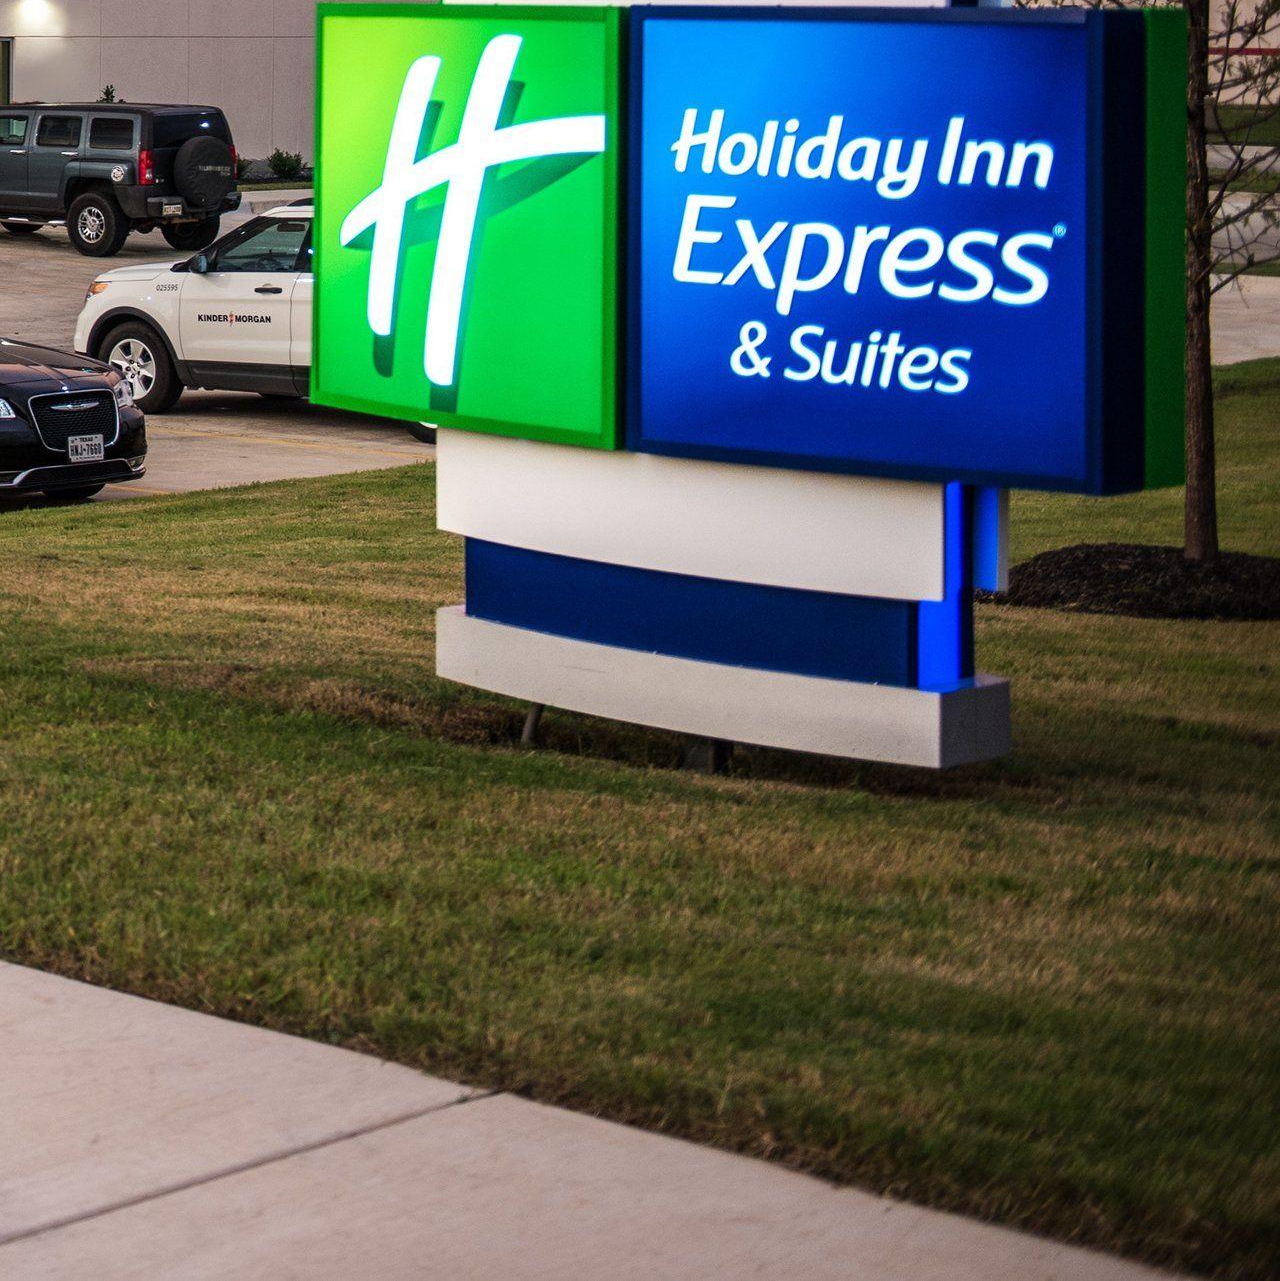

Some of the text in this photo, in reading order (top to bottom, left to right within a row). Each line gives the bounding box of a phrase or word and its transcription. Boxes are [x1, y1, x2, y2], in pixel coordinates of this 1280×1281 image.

[670, 108, 1055, 199] Holiday Inn
[340, 33, 606, 386] H
[197, 314, 271, 323] KINDER MORGAN
[730, 320, 972, 394] & Suites
